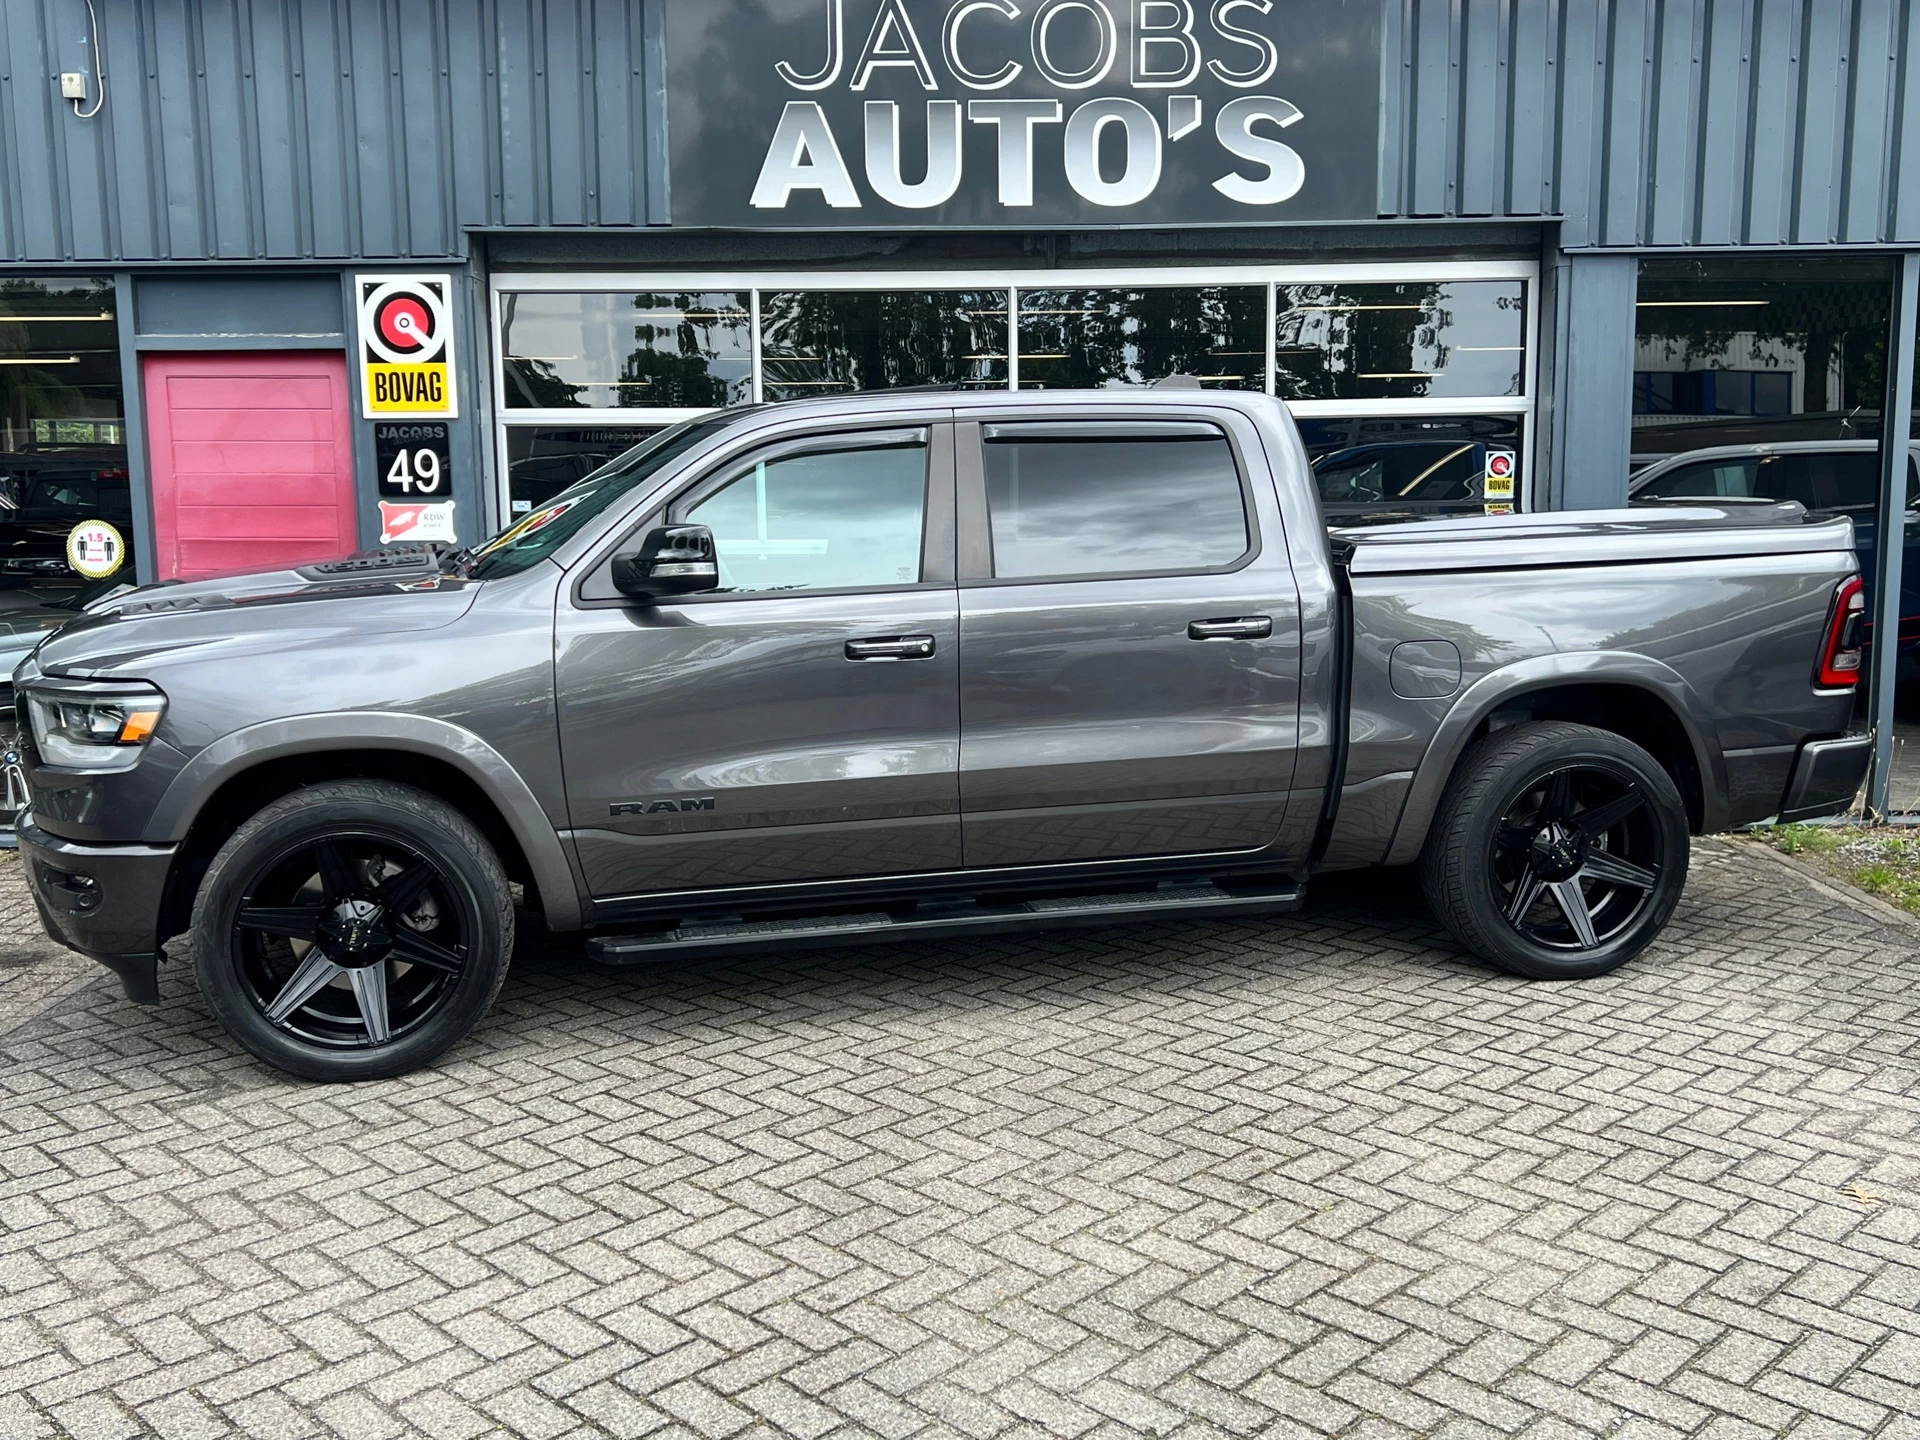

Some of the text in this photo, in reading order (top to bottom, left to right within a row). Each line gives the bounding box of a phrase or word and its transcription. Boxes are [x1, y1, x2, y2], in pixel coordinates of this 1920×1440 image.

[774, 0, 1277, 92] JACOBS
[749, 95, 1305, 208] AUTO'S
[374, 371, 442, 403] BOVAG
[378, 426, 445, 439] JACOBS
[386, 448, 440, 493] 49
[1488, 480, 1511, 490] BOVAG
[423, 513, 446, 521] RDW
[87, 533, 104, 543] 1.5
[608, 796, 716, 816] RAM
